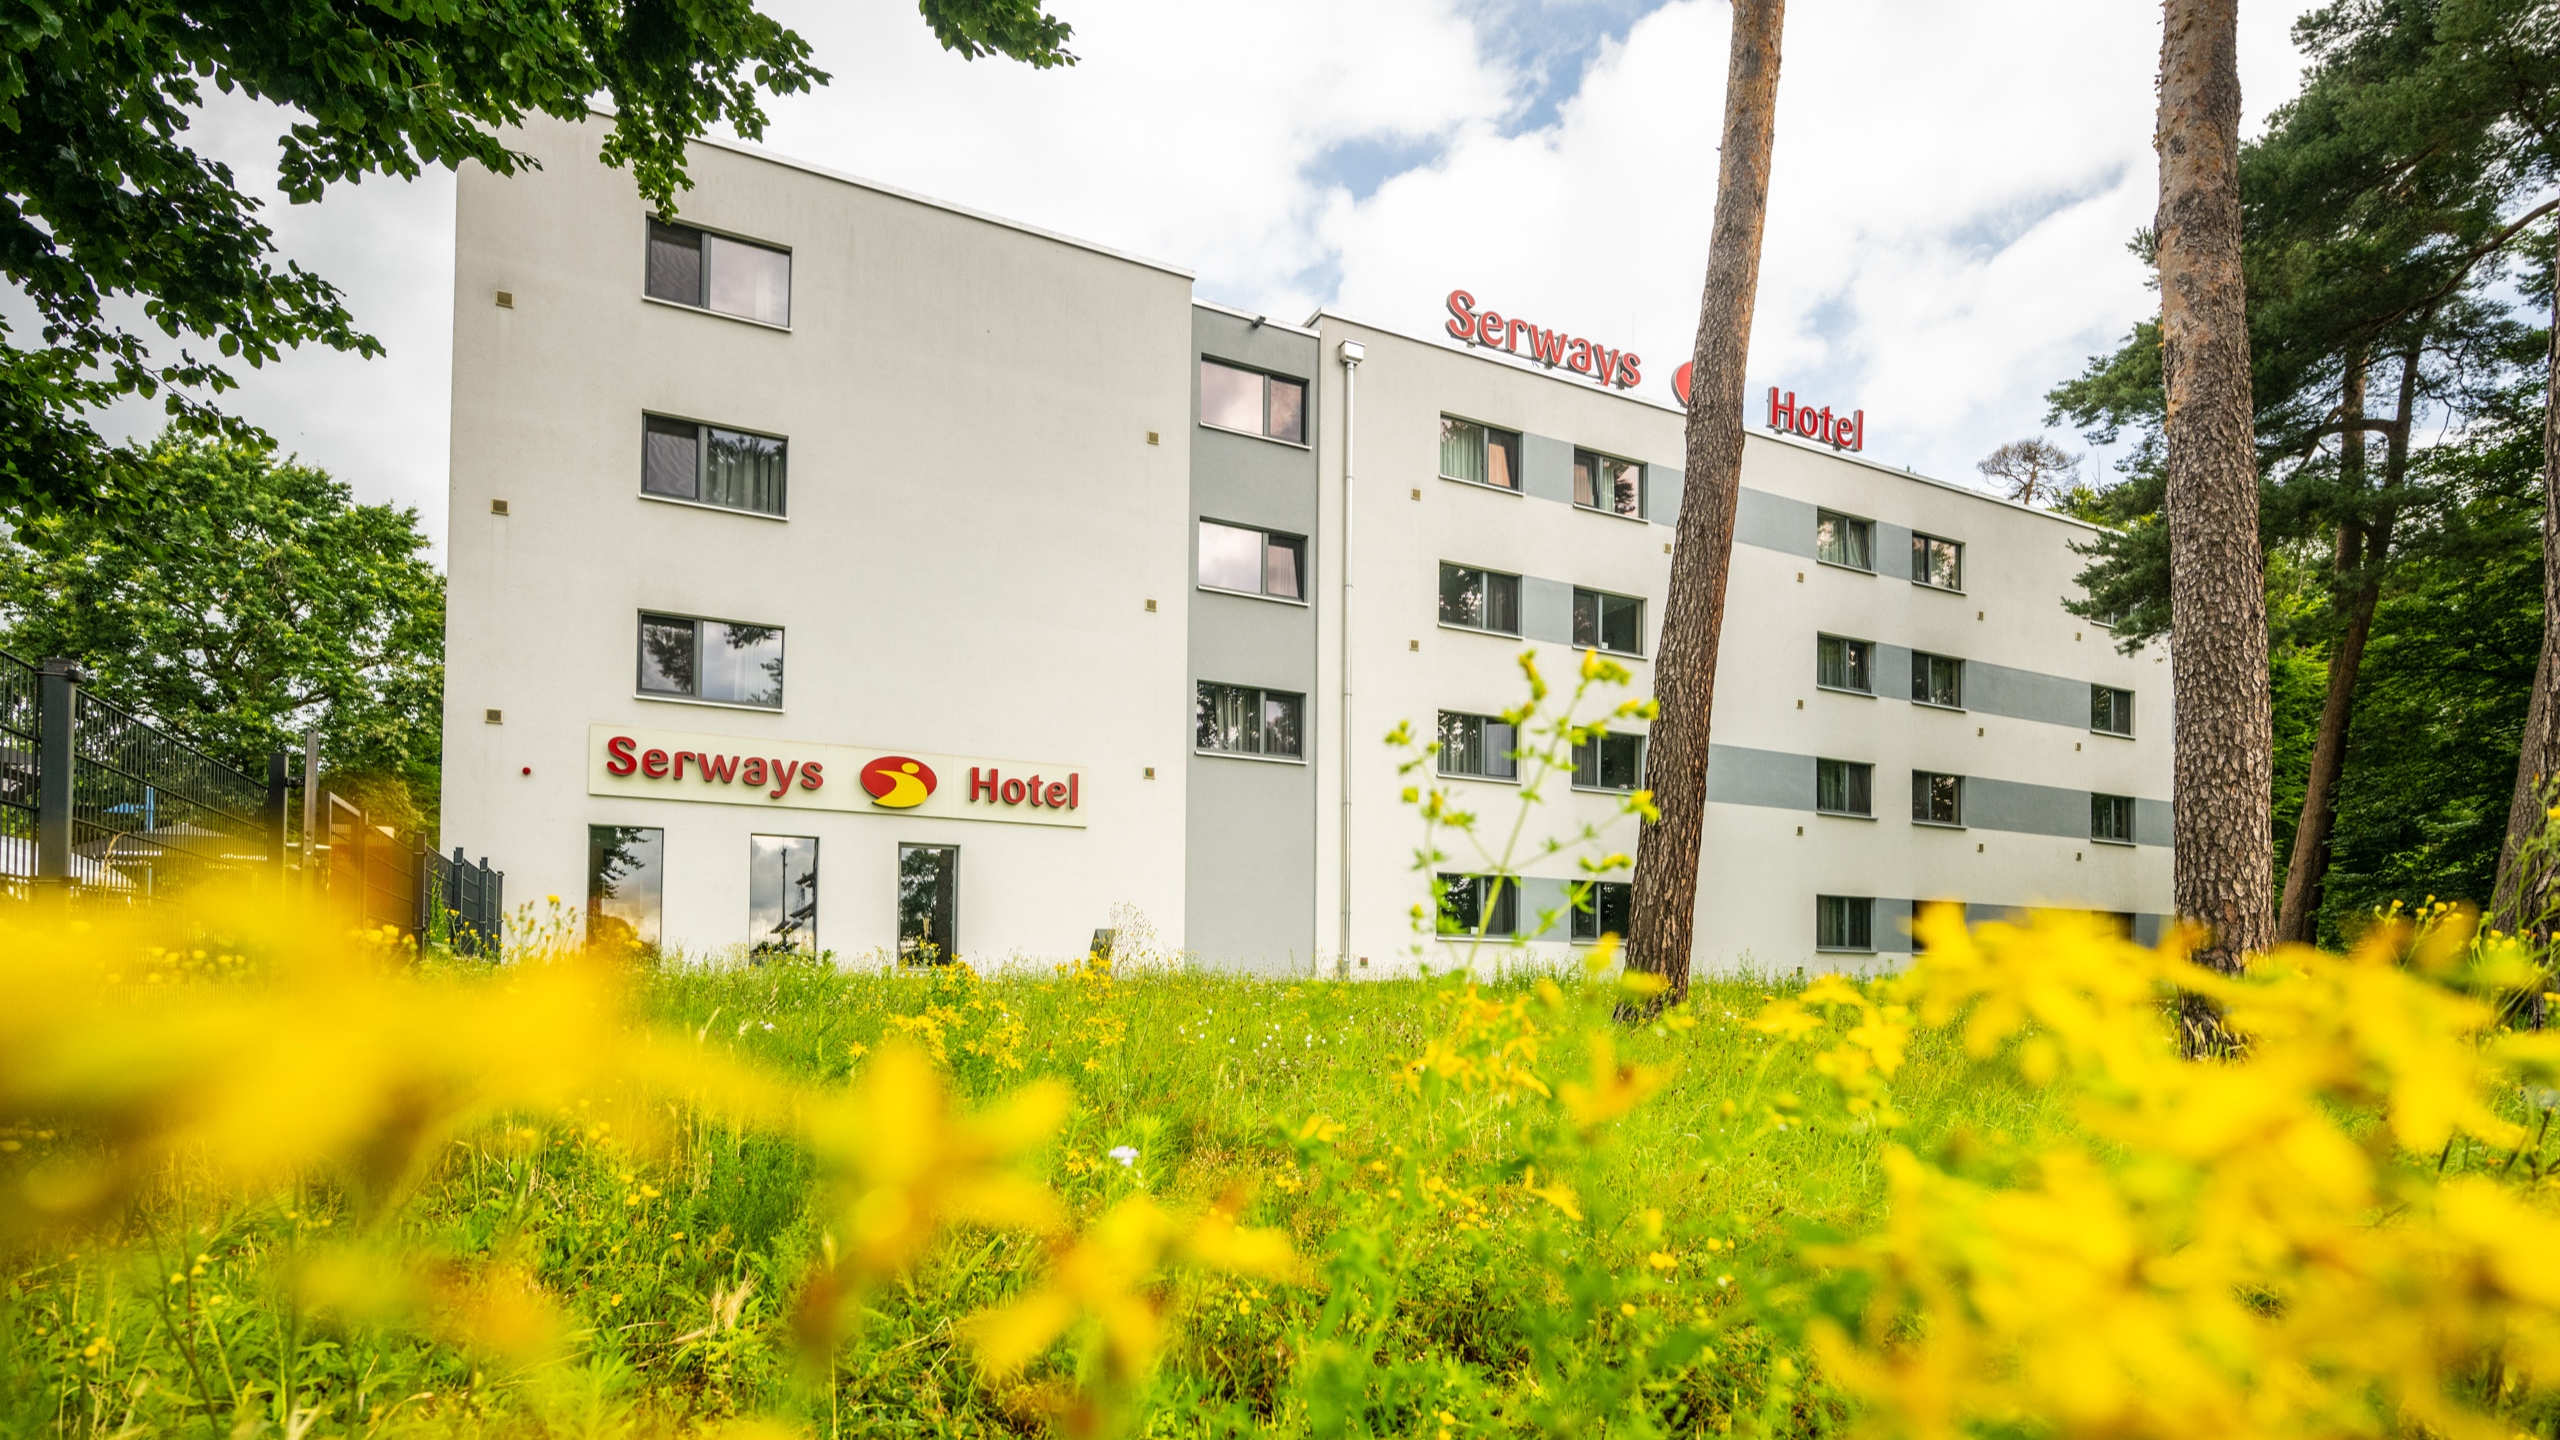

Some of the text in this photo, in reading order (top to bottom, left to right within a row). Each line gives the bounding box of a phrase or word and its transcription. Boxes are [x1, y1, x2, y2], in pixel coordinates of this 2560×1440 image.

[1446, 289, 1864, 451] Serways Hotel
[606, 735, 1080, 809] Serways Hotel
